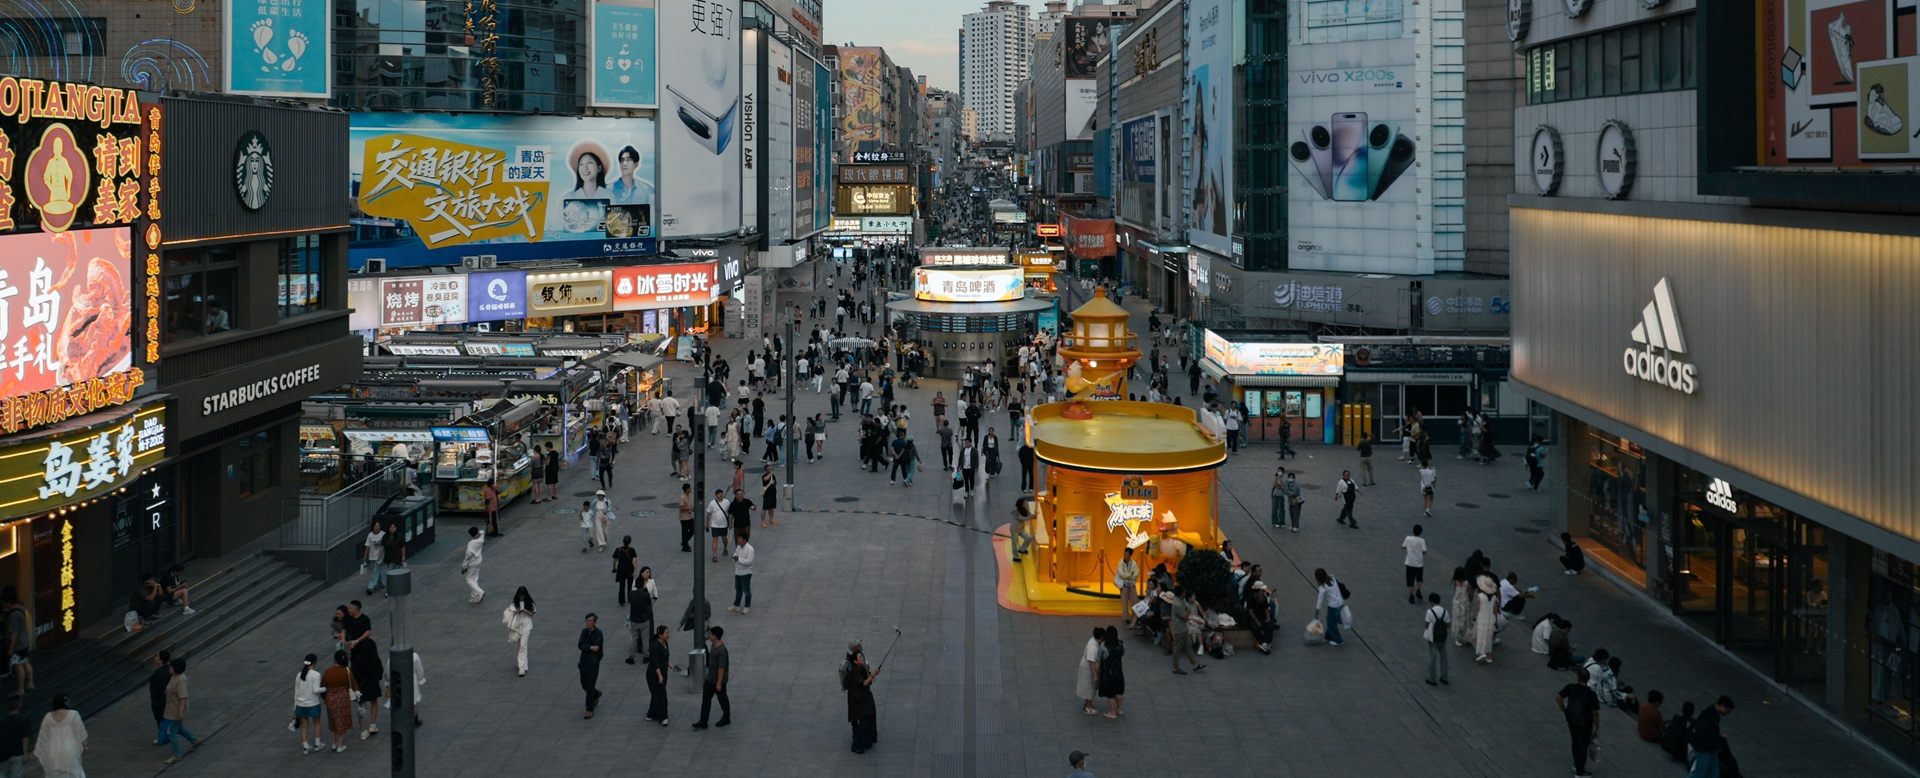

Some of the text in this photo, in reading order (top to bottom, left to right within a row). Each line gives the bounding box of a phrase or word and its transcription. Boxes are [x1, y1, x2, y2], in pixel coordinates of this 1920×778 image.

[258, 6, 302, 17] 低碳生活
[611, 31, 638, 40] 良好习惯
[612, 22, 638, 31] 卫生健康
[1299, 69, 1395, 84] vivo X200s
[93, 133, 141, 179] 请到
[149, 107, 161, 220] 青岛伴手礼
[520, 150, 545, 163] 青岛
[362, 138, 507, 199] 交通银行
[508, 165, 545, 180] 的夏天
[844, 169, 904, 181] 现代眼镜城
[93, 178, 141, 224] 姜家
[418, 186, 537, 244] 文旅大戏
[868, 220, 907, 228] 章鱼小丸子
[614, 242, 644, 250] 交通银行
[692, 248, 714, 256] vivo
[723, 256, 739, 281] vivo
[431, 282, 447, 291] 冷面
[637, 272, 709, 295] 冰雪时光
[942, 280, 996, 294] 青岛啤酒
[387, 291, 420, 309] 烧烤
[1296, 284, 1343, 303] 迪信通
[0, 332, 60, 384] 手礼
[1624, 346, 1698, 395] adidas
[203, 364, 320, 416] STARBUCKS COFFEE
[1, 367, 144, 434] 非物质文化遗产
[144, 417, 158, 428] DAO
[38, 424, 136, 499] 岛姜家
[1706, 490, 1737, 513] adidas
[152, 512, 160, 530] R
